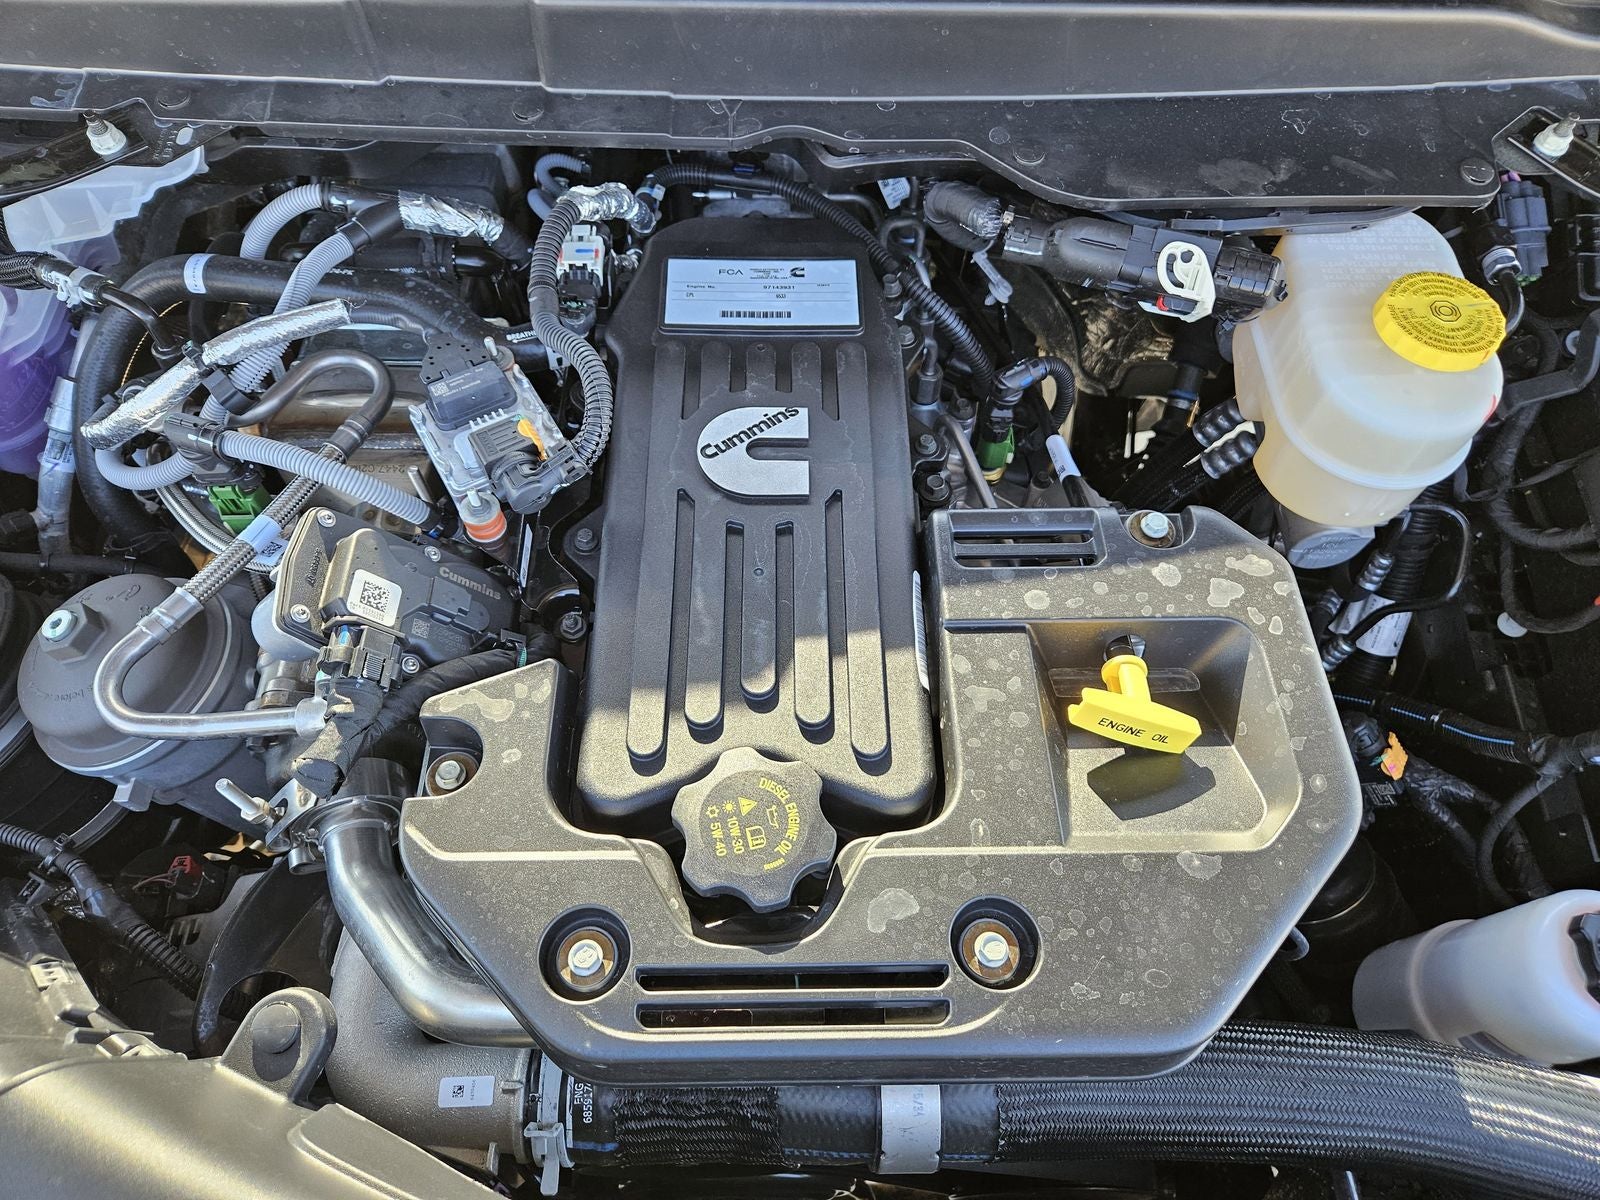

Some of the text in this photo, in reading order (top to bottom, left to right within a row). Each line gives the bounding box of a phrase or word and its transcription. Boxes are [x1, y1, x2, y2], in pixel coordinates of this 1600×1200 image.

[699, 407, 800, 459] Cummins
[439, 566, 503, 600] Cummins
[1098, 717, 1169, 744] ENGINE OIL
[758, 777, 791, 804] DIESEL
[726, 815, 745, 854] 10W-30
[785, 802, 801, 842] ENGINE
[710, 822, 728, 857] 5W-40
[773, 840, 792, 856] OIL
